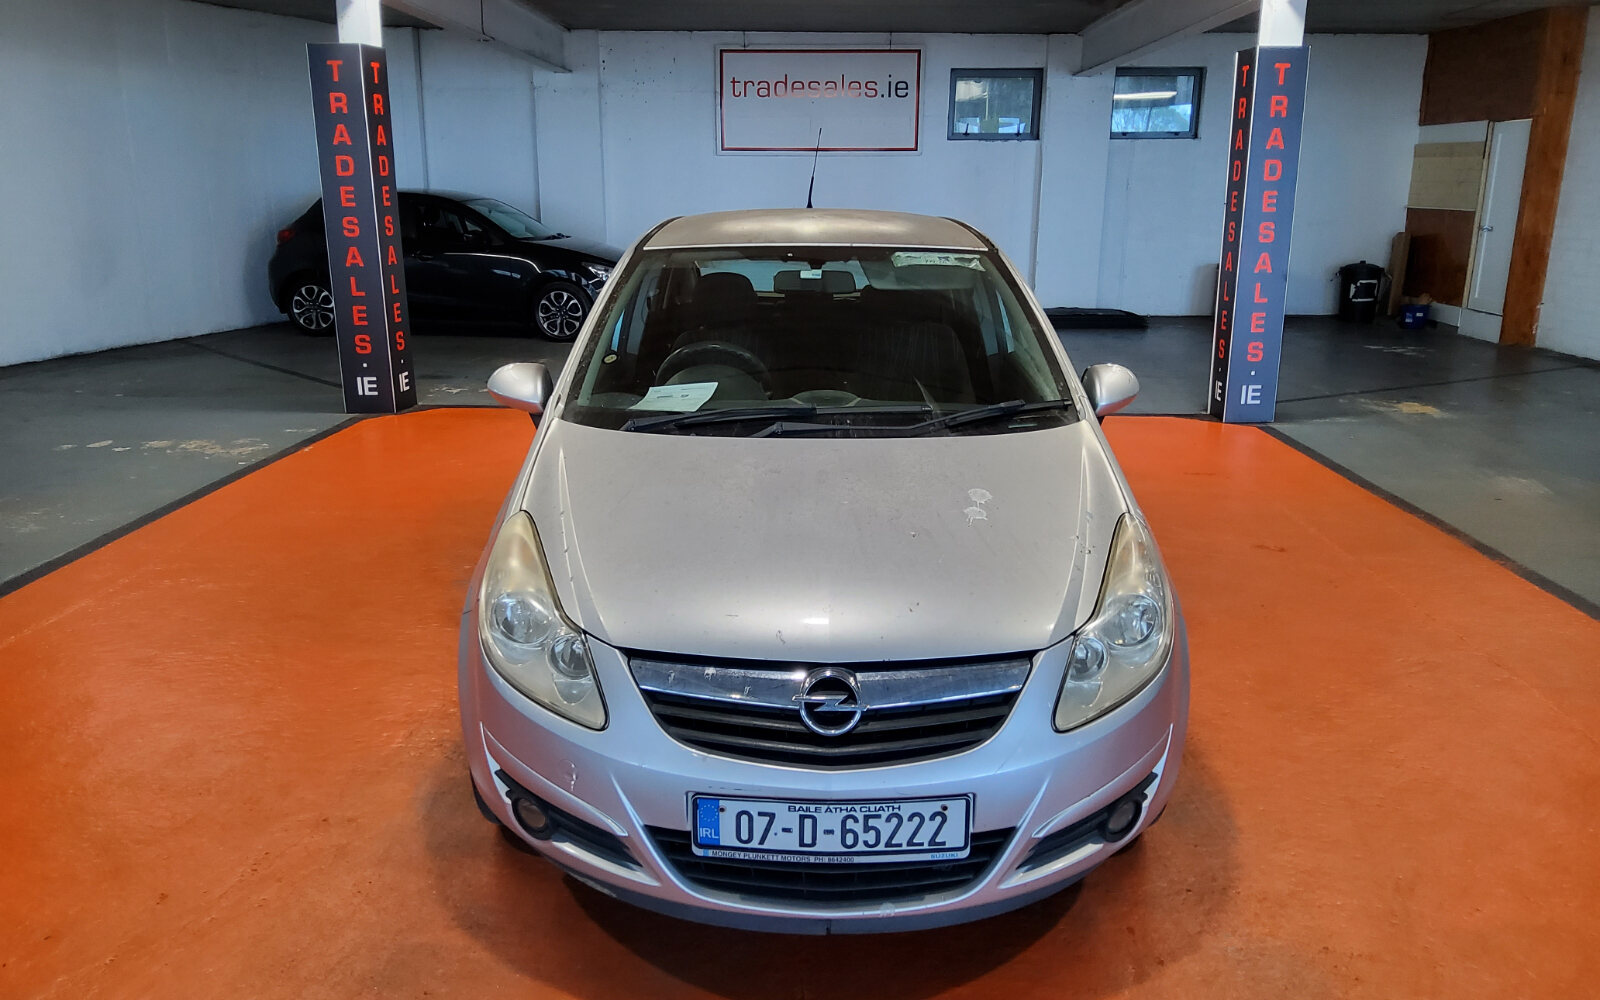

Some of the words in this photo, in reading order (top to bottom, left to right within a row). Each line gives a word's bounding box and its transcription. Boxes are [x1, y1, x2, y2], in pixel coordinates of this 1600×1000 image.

[730, 74, 909, 98] tradesales.ie
[787, 805, 822, 814] BAILE
[860, 805, 901, 813] CLIATH
[700, 827, 719, 839] IRL
[735, 810, 948, 849] 07-D-65222
[711, 850, 741, 858] MONGEY
[743, 852, 779, 861] PLUNKETT
[930, 852, 959, 860] SUZUKI
